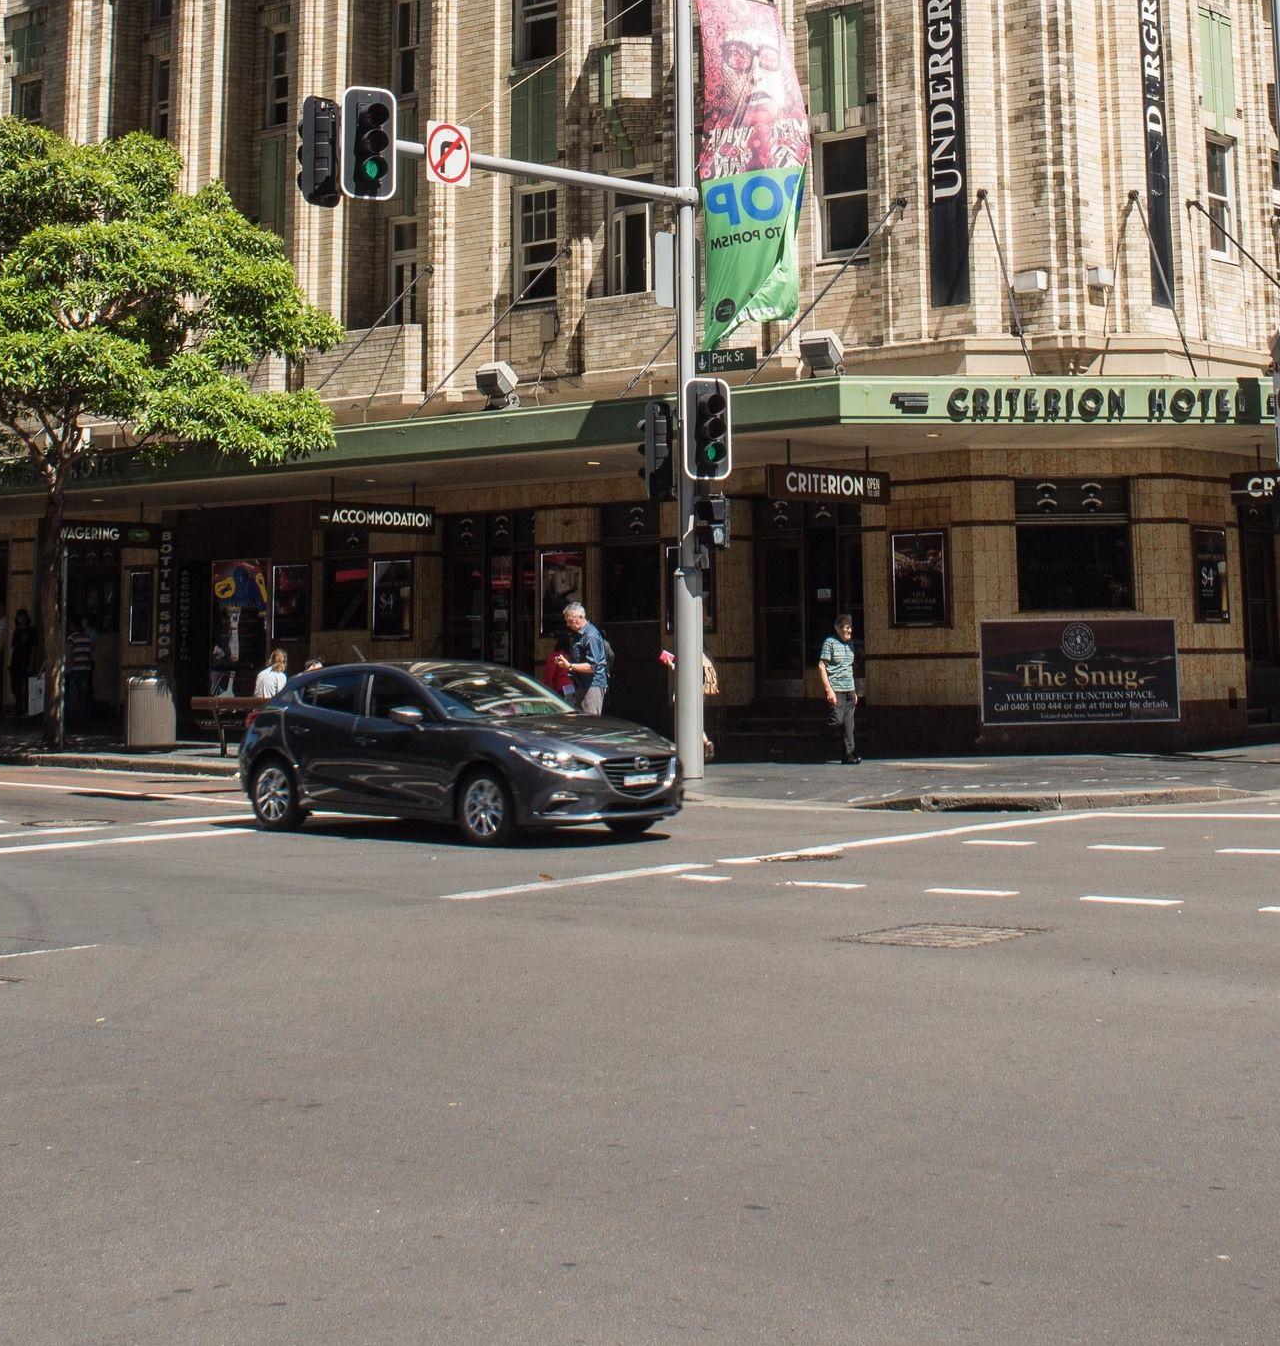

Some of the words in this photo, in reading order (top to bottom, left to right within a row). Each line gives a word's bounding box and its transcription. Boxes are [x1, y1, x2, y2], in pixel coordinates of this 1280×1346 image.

[711, 352, 733, 364] Park
[734, 350, 744, 362] St
[947, 387, 1126, 422] CRITERION
[1148, 388, 1247, 423] HOTEL
[785, 470, 864, 496] CRITERION
[866, 477, 880, 490] OPEN
[331, 508, 433, 528] ACCOMMODATION
[160, 531, 172, 603] BOTTLE
[158, 611, 171, 659] SHOP
[1016, 662, 1067, 688] The
[1074, 662, 1145, 690] Snug.
[994, 702, 1009, 712] Call
[1010, 702, 1030, 712] 0405
[1033, 702, 1046, 710] 100
[1047, 702, 1062, 710] 444
[1074, 701, 1087, 710] ask
[1088, 702, 1097, 710] at
[1098, 701, 1112, 709] the
[1114, 701, 1127, 709] bar
[1129, 700, 1140, 709] for
[1142, 699, 1168, 709] details
[1006, 693, 1032, 702] YOUR
[1034, 692, 1073, 701] PERFECT
[1076, 691, 1124, 701] FUNCTION
[1125, 690, 1156, 700] SPACE.
